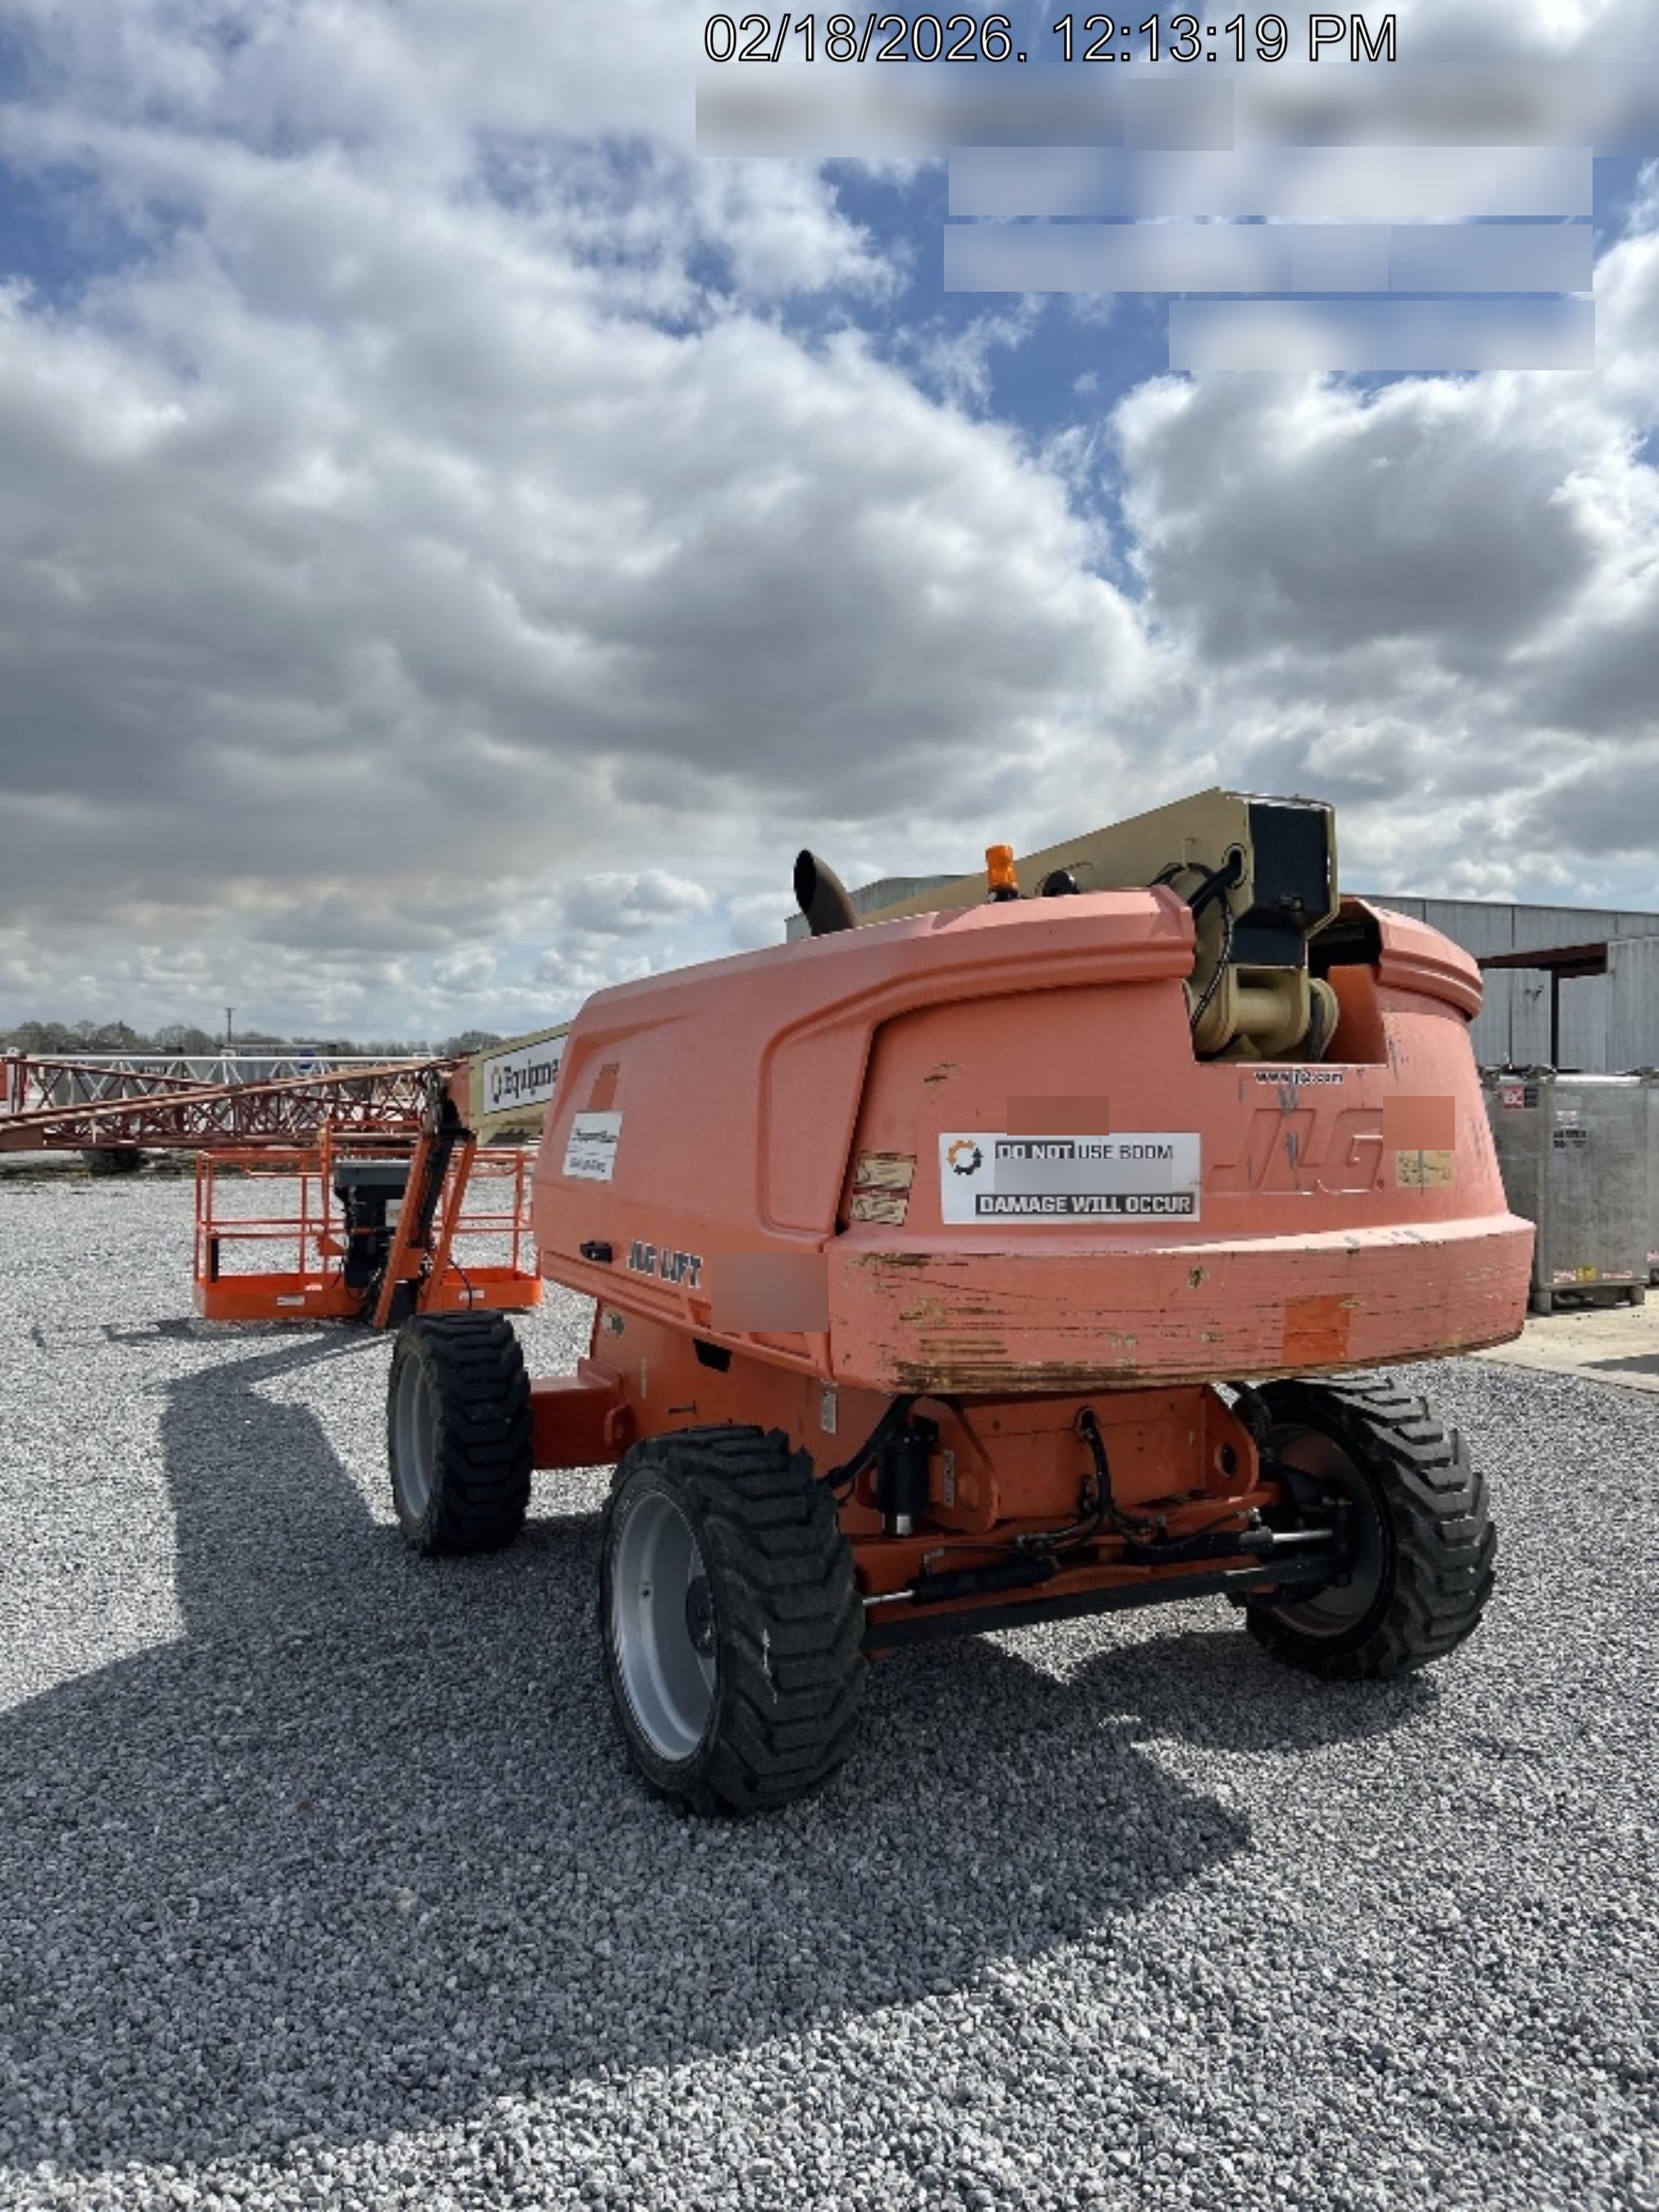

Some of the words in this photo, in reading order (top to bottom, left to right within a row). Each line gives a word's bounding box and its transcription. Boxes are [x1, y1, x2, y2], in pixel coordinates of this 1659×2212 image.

[998, 1145, 1026, 1159] DO
[1032, 1145, 1072, 1159] NOT
[1078, 1145, 1113, 1159] USE
[1120, 1145, 1173, 1159] BOOM
[1203, 1108, 1388, 1195] JLG
[980, 1196, 1067, 1213] DAMAGE
[1071, 1196, 1122, 1213] WILL
[1126, 1196, 1190, 1213] OCCUR
[627, 1239, 656, 1276] JLG
[659, 1249, 703, 1289] LIFT
